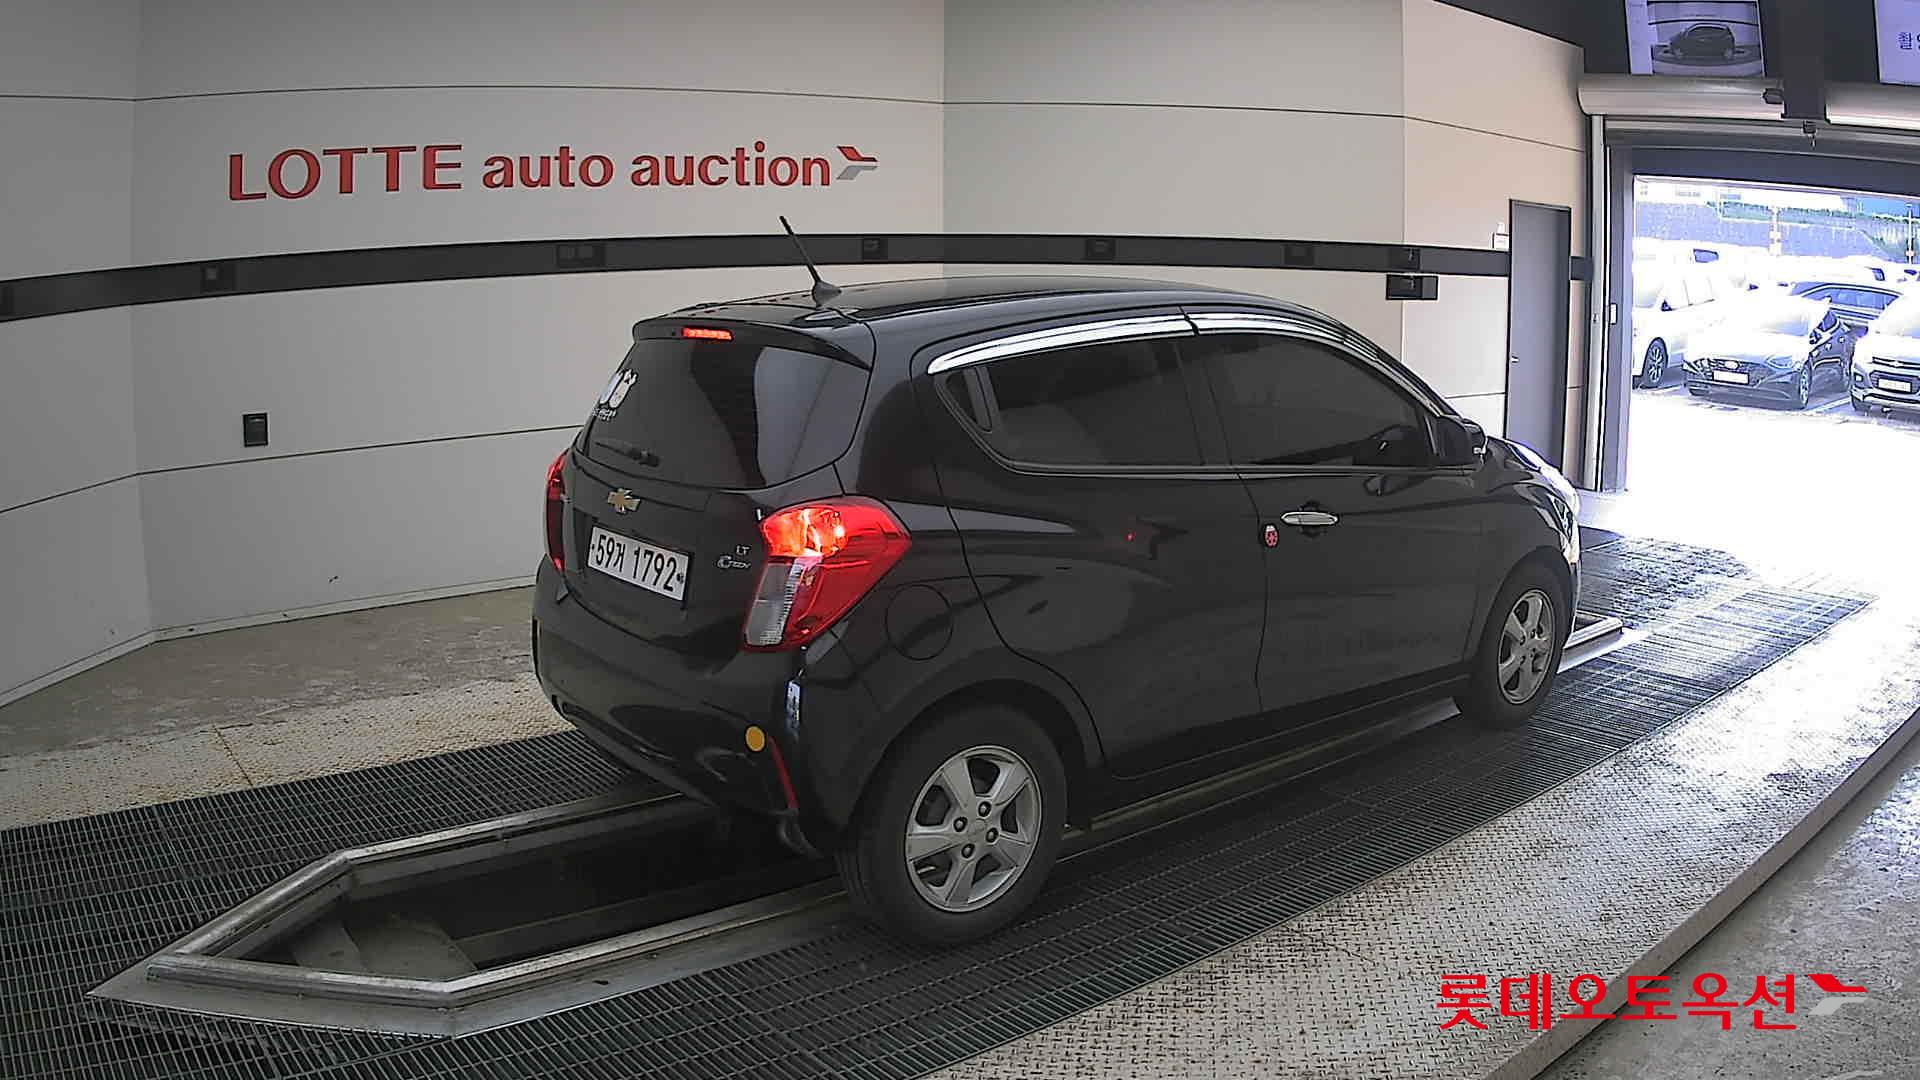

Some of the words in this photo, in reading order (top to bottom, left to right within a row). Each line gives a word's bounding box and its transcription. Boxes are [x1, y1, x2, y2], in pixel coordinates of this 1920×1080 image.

[230, 146, 463, 201] LOTTE
[484, 147, 615, 187] auto
[632, 142, 831, 186] auction
[596, 534, 626, 573] 59거
[633, 546, 677, 592] 1792
